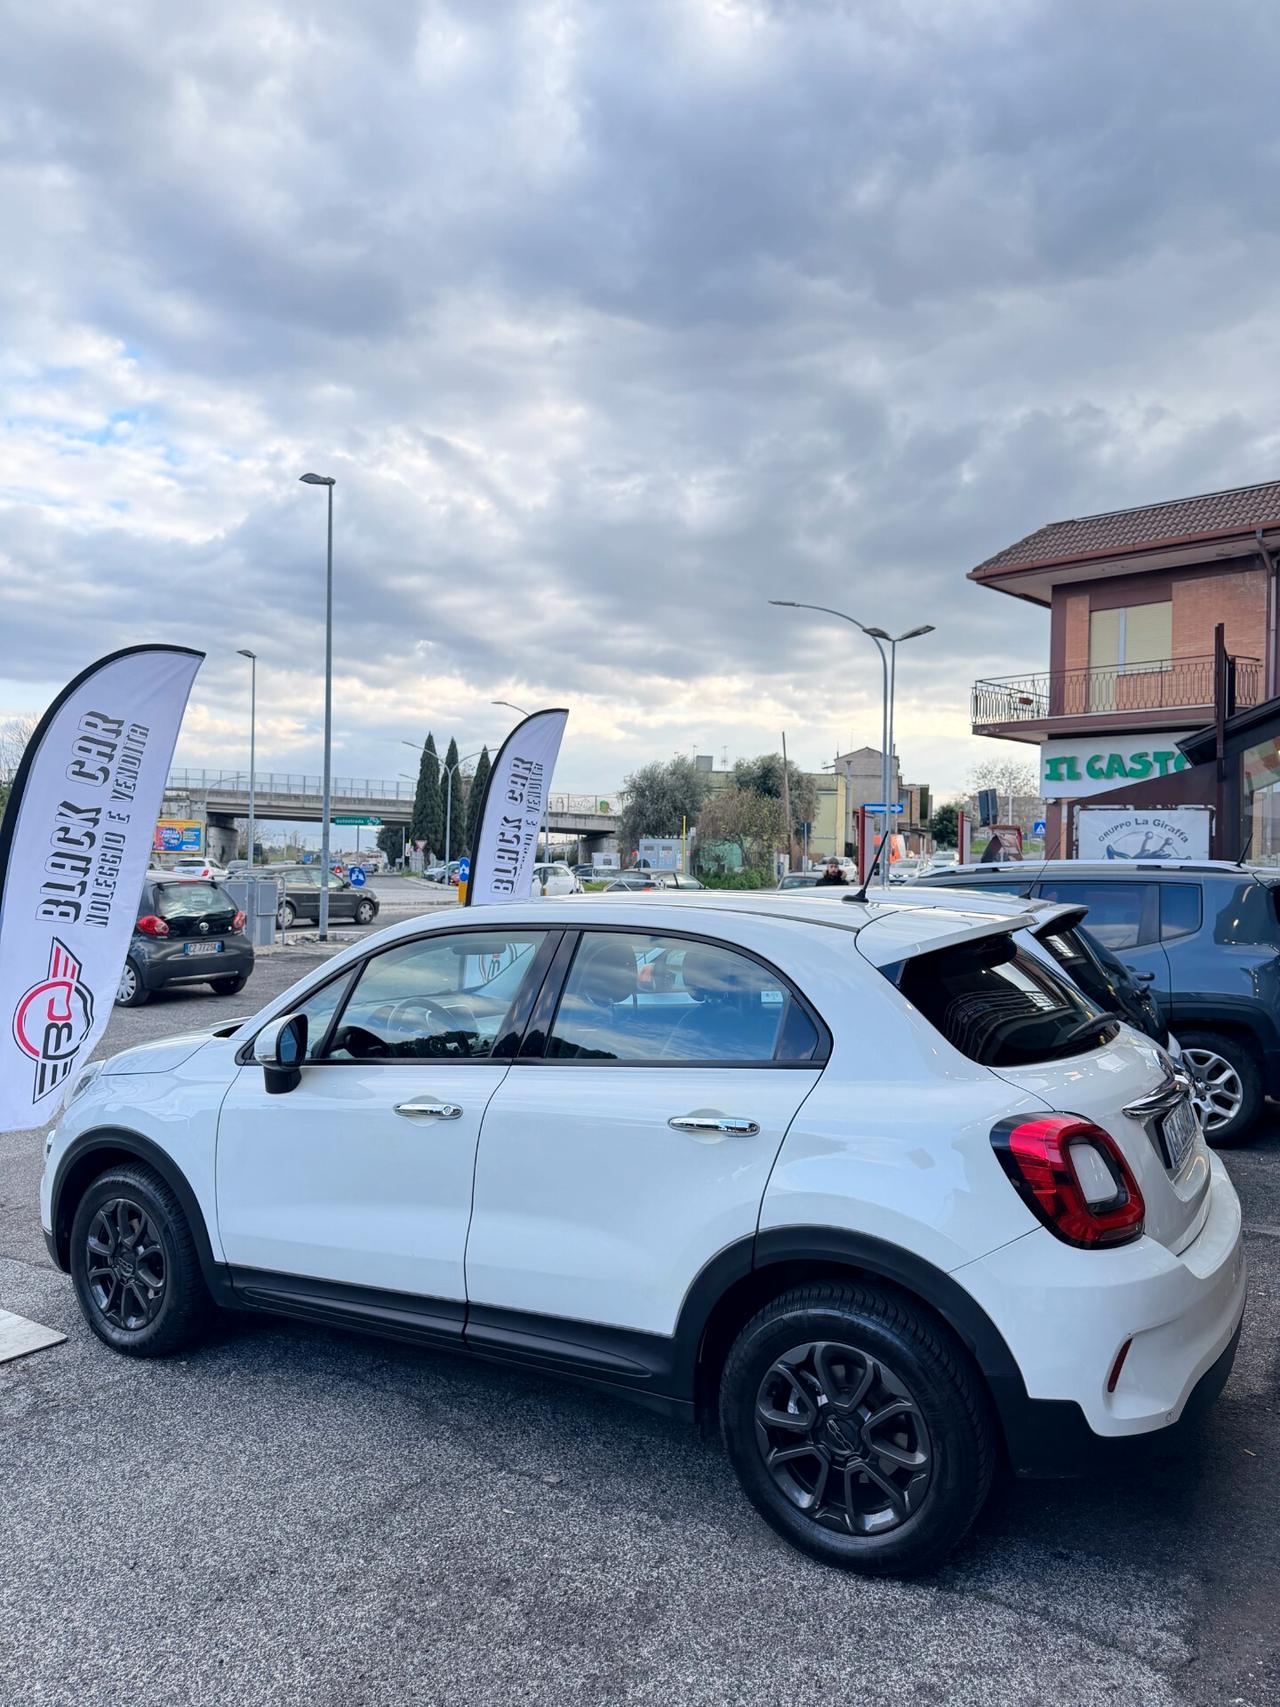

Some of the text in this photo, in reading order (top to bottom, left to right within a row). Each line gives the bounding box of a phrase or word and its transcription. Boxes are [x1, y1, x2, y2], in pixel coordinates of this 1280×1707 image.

[505, 756, 534, 806] CAR
[1044, 756, 1082, 781] IL
[35, 710, 125, 925] BLACK CAR
[84, 723, 150, 928] NOLEGGIO E VENDITA
[1134, 818, 1149, 826] La
[1152, 818, 1189, 843] Giraffa
[490, 815, 523, 895] BLACK
